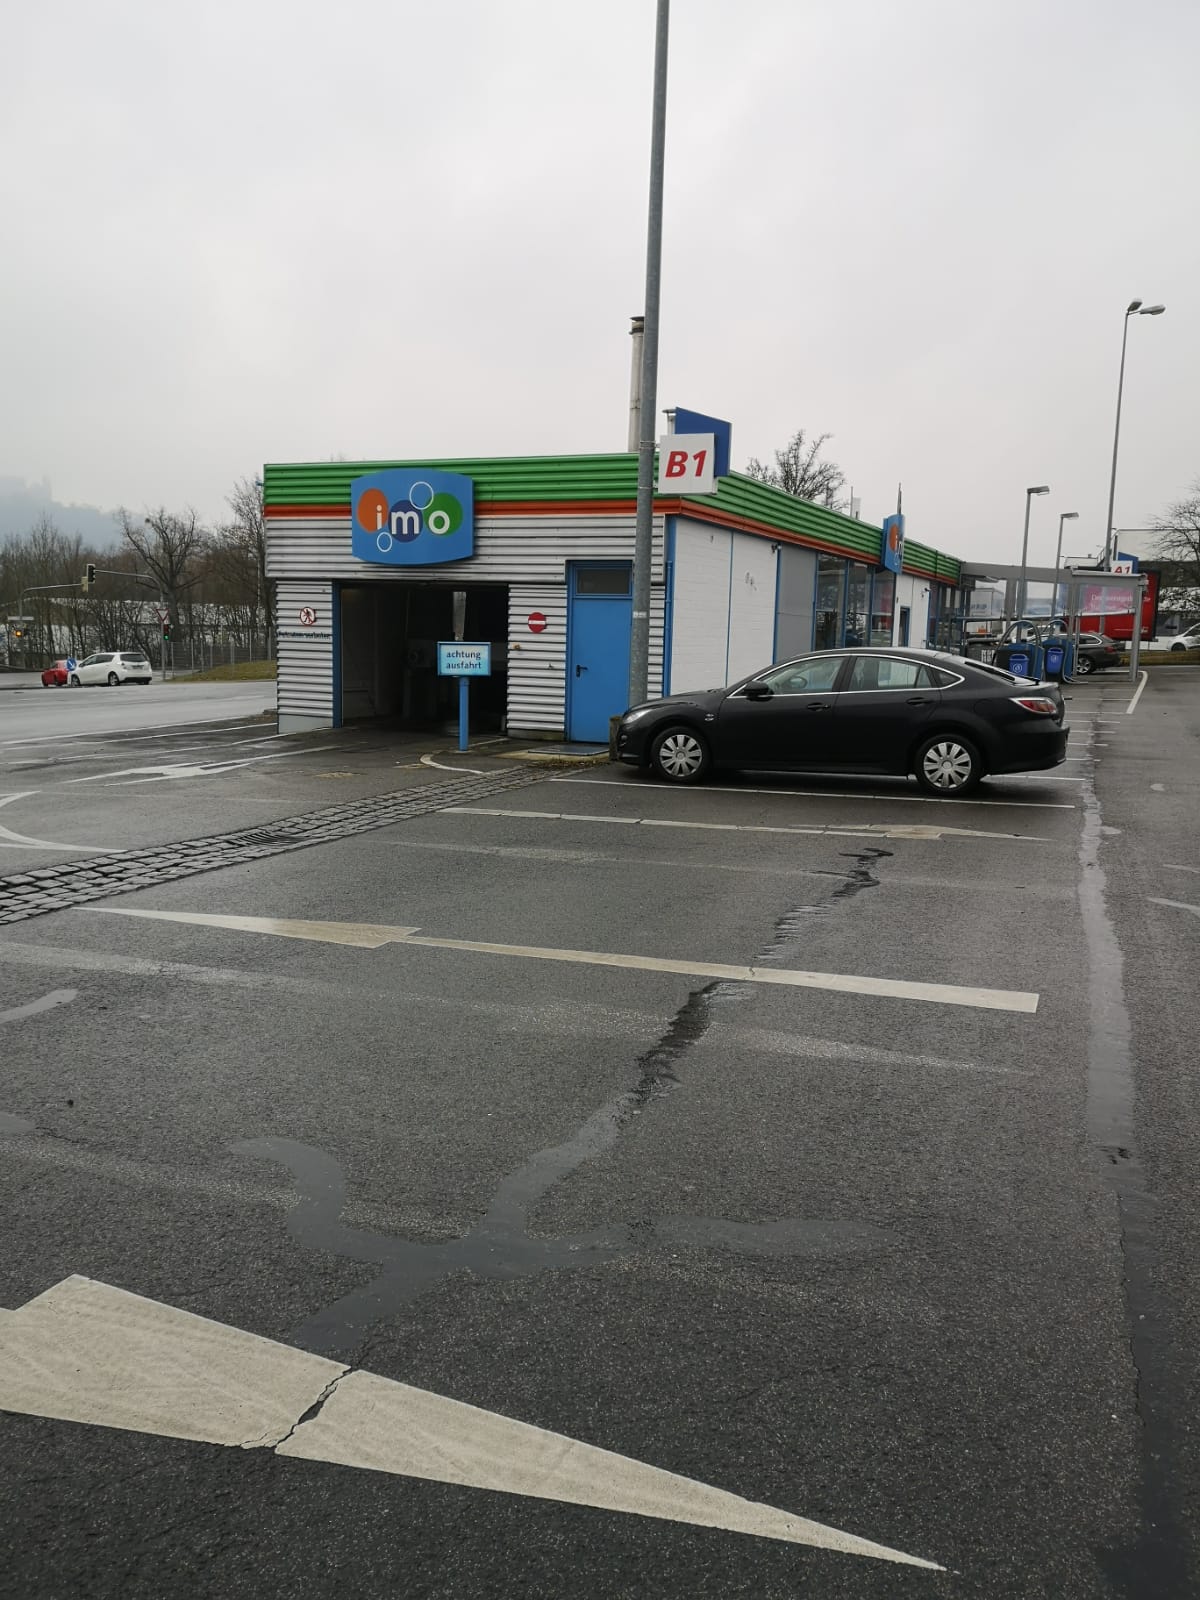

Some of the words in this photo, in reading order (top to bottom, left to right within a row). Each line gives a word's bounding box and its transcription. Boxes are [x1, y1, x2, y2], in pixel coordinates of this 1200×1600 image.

[665, 450, 708, 478] B1
[376, 504, 450, 535] imo
[1114, 566, 1131, 574] A1
[446, 650, 481, 660] achtung
[446, 661, 482, 669] ausfahrt
